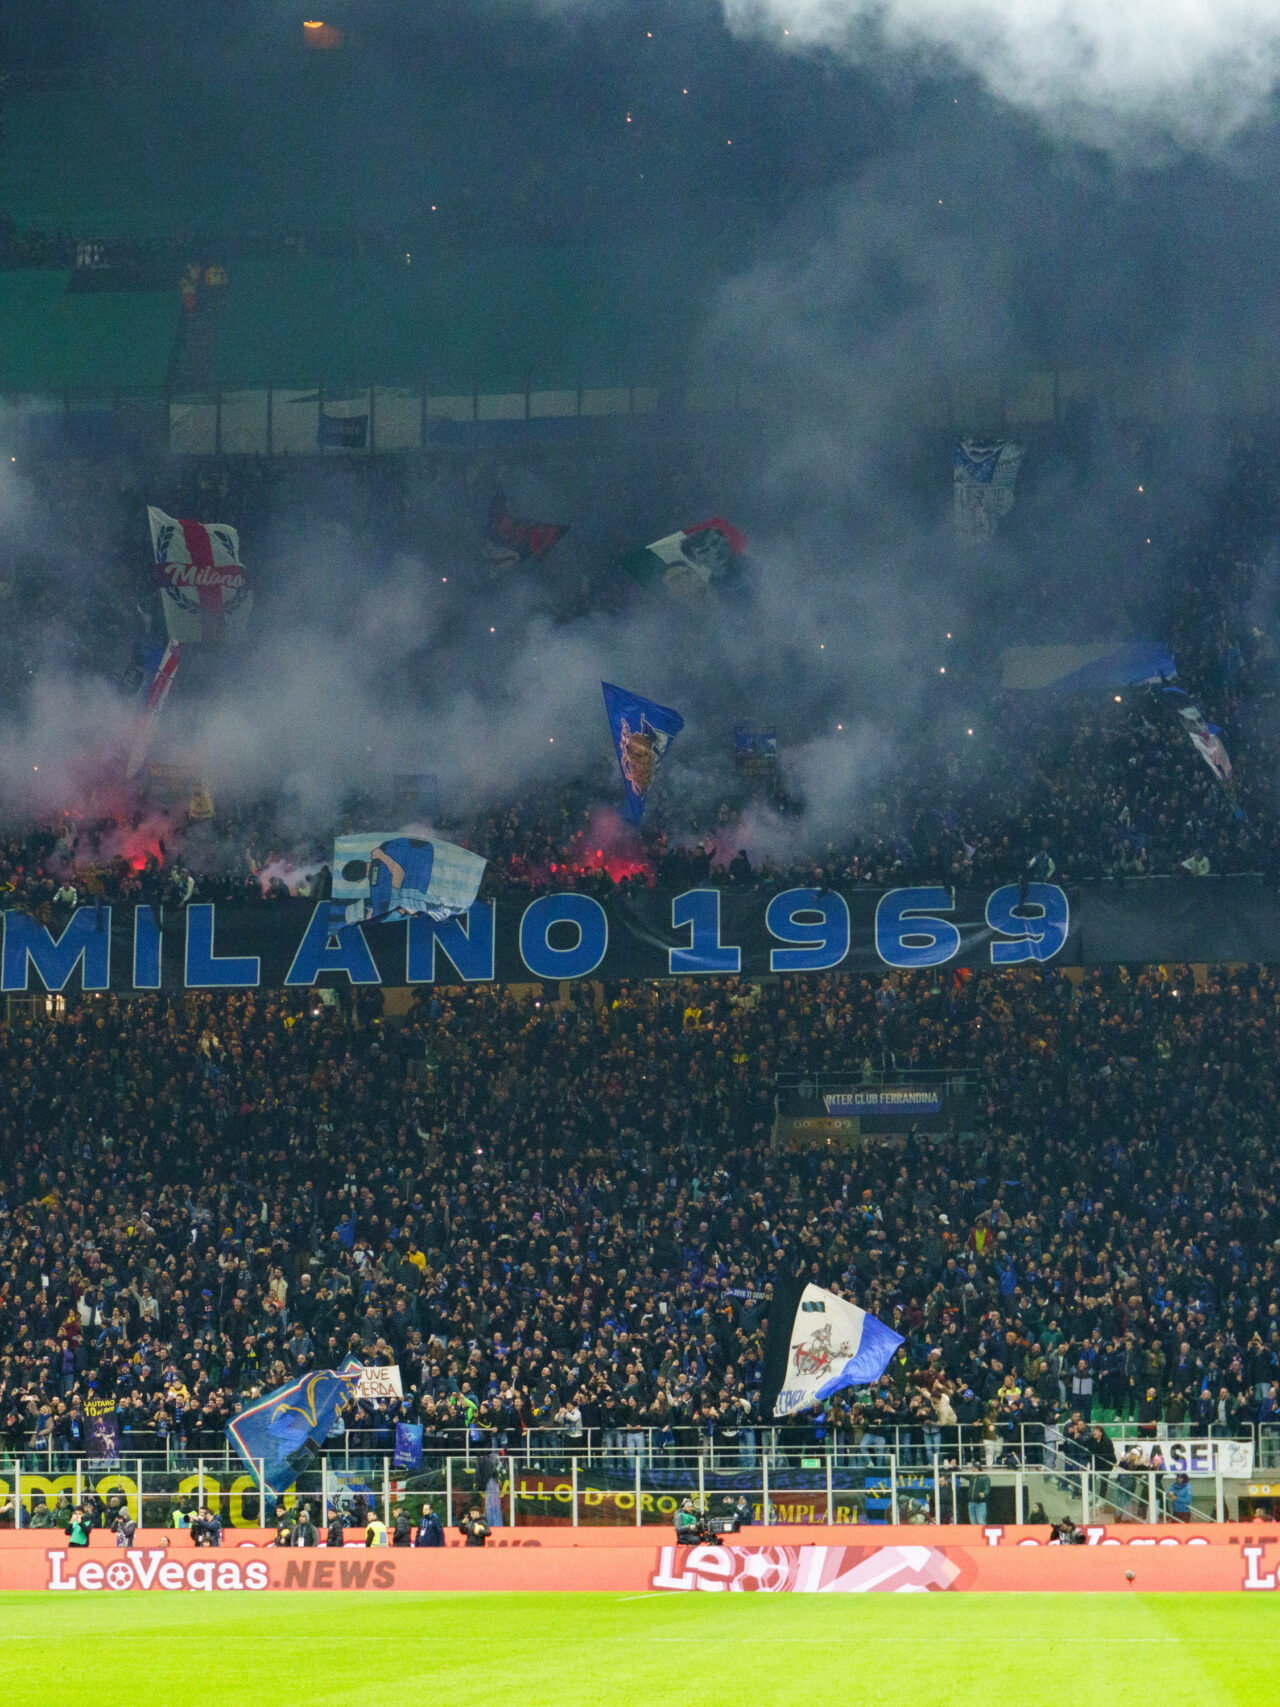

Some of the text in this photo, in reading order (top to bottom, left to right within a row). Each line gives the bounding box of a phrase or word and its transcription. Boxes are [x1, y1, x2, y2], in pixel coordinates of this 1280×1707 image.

[164, 562, 246, 588] Milano
[0, 890, 609, 992] MILANO
[668, 881, 1071, 975] 1969
[354, 1380, 398, 1397] MERDA
[84, 1399, 115, 1407] LAUTARO
[473, 1479, 678, 1514] ALLO D'ORO
[752, 1502, 858, 1525] TEMPLARI
[1242, 1547, 1280, 1590] L
